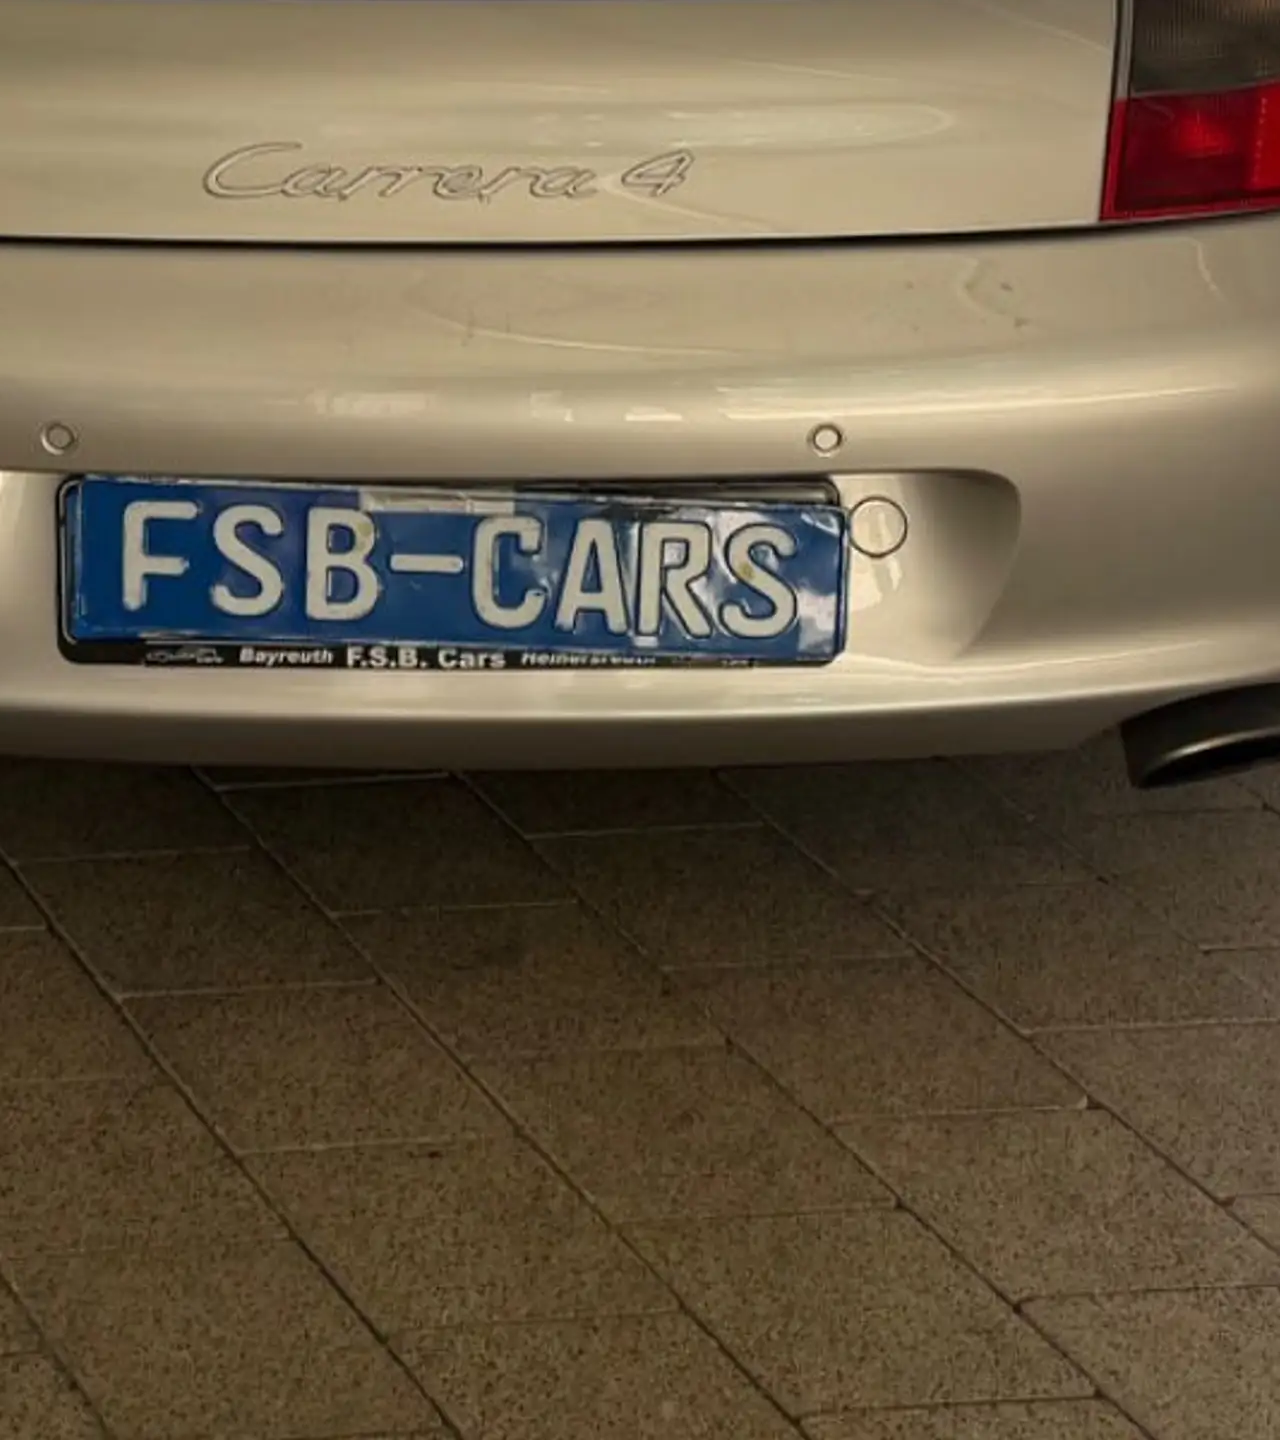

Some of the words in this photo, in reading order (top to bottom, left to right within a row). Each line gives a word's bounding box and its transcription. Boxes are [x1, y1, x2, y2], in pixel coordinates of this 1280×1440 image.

[203, 142, 598, 203] Carrera
[621, 150, 695, 198] 4
[122, 499, 799, 640] FSB-CARS
[238, 645, 334, 668] Bayreuth
[346, 646, 428, 669] F.S.B.
[437, 647, 507, 669] Cars
